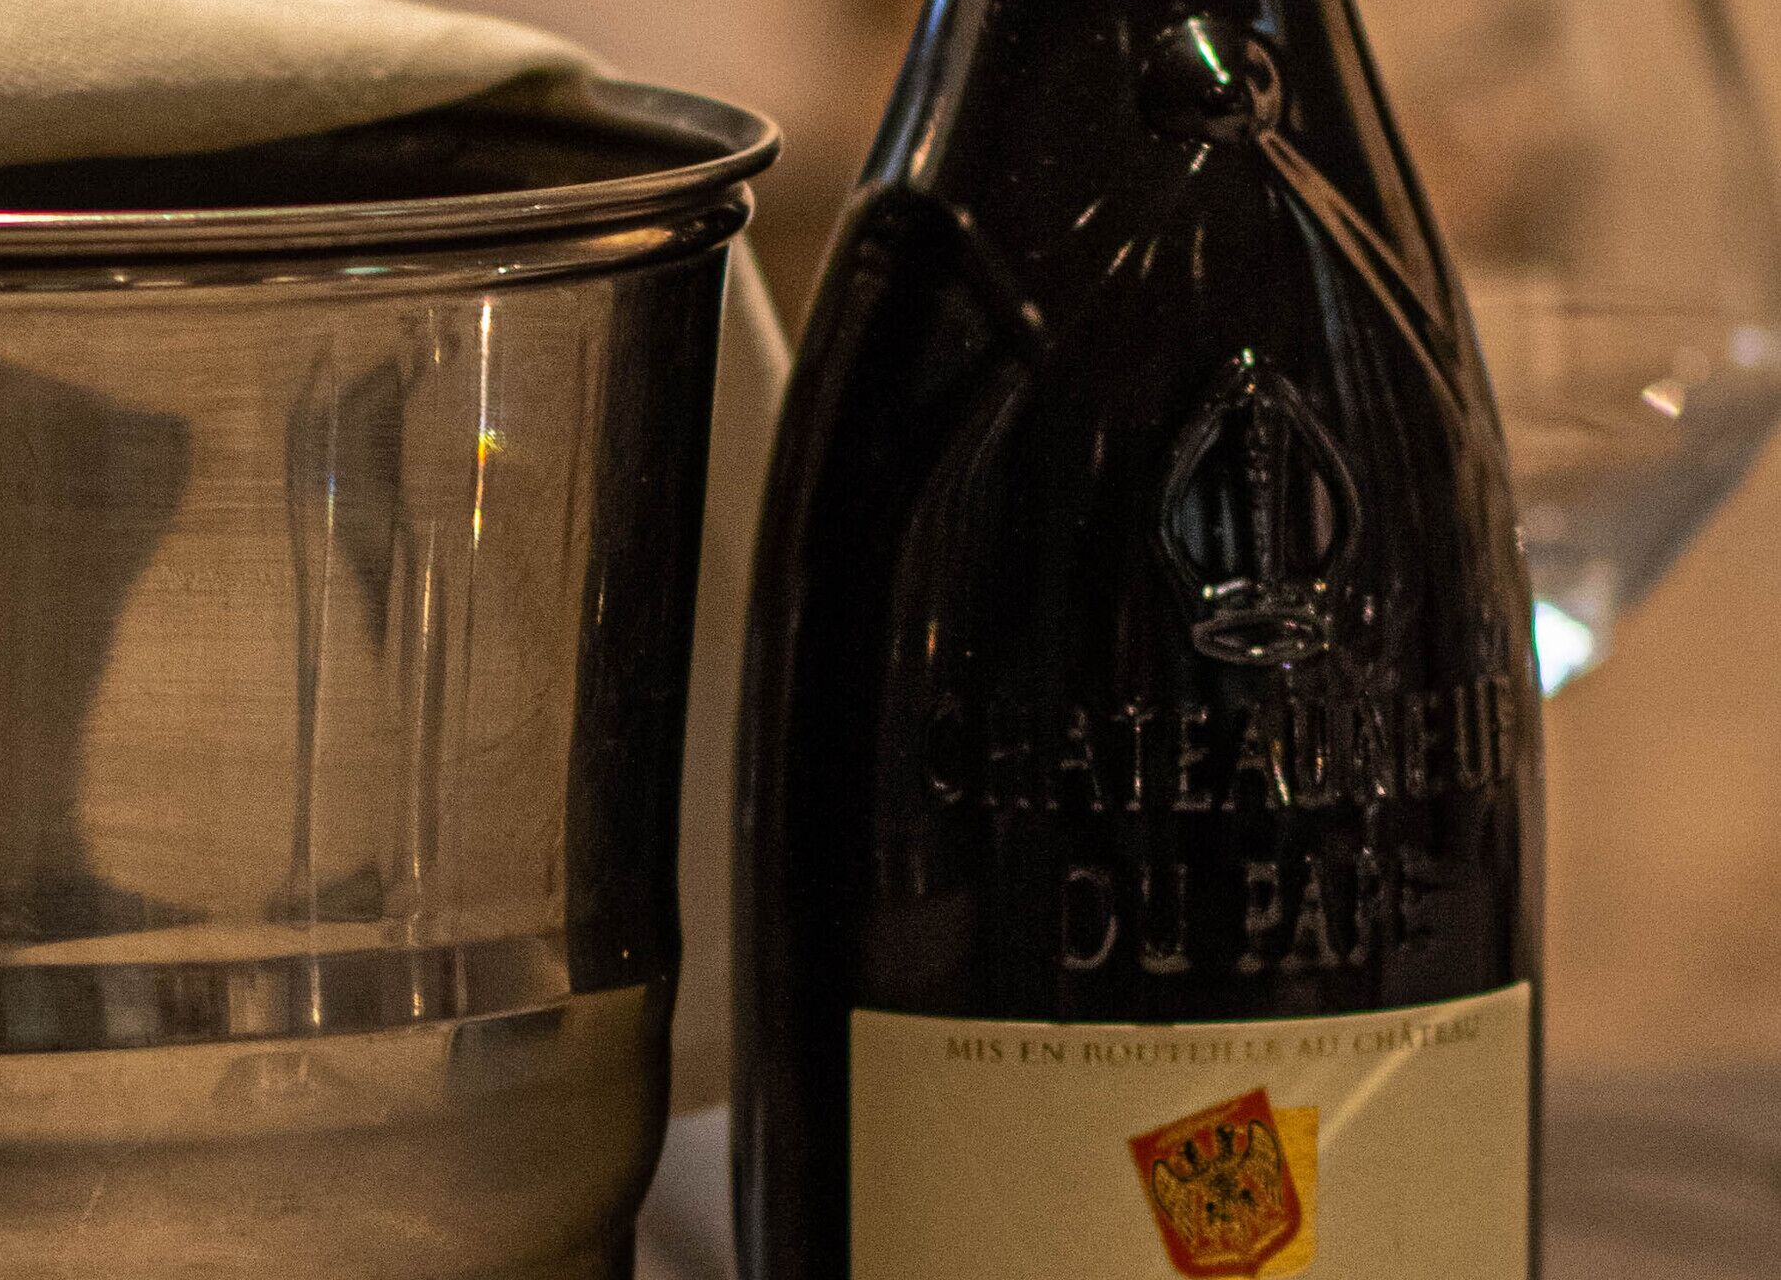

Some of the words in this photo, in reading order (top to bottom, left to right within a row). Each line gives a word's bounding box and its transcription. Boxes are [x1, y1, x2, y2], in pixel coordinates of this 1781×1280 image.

[1060, 861, 1192, 972] DU
[946, 1036, 1004, 1063] MIS
[1019, 1039, 1066, 1065] EN
[1297, 1037, 1341, 1059] AU
